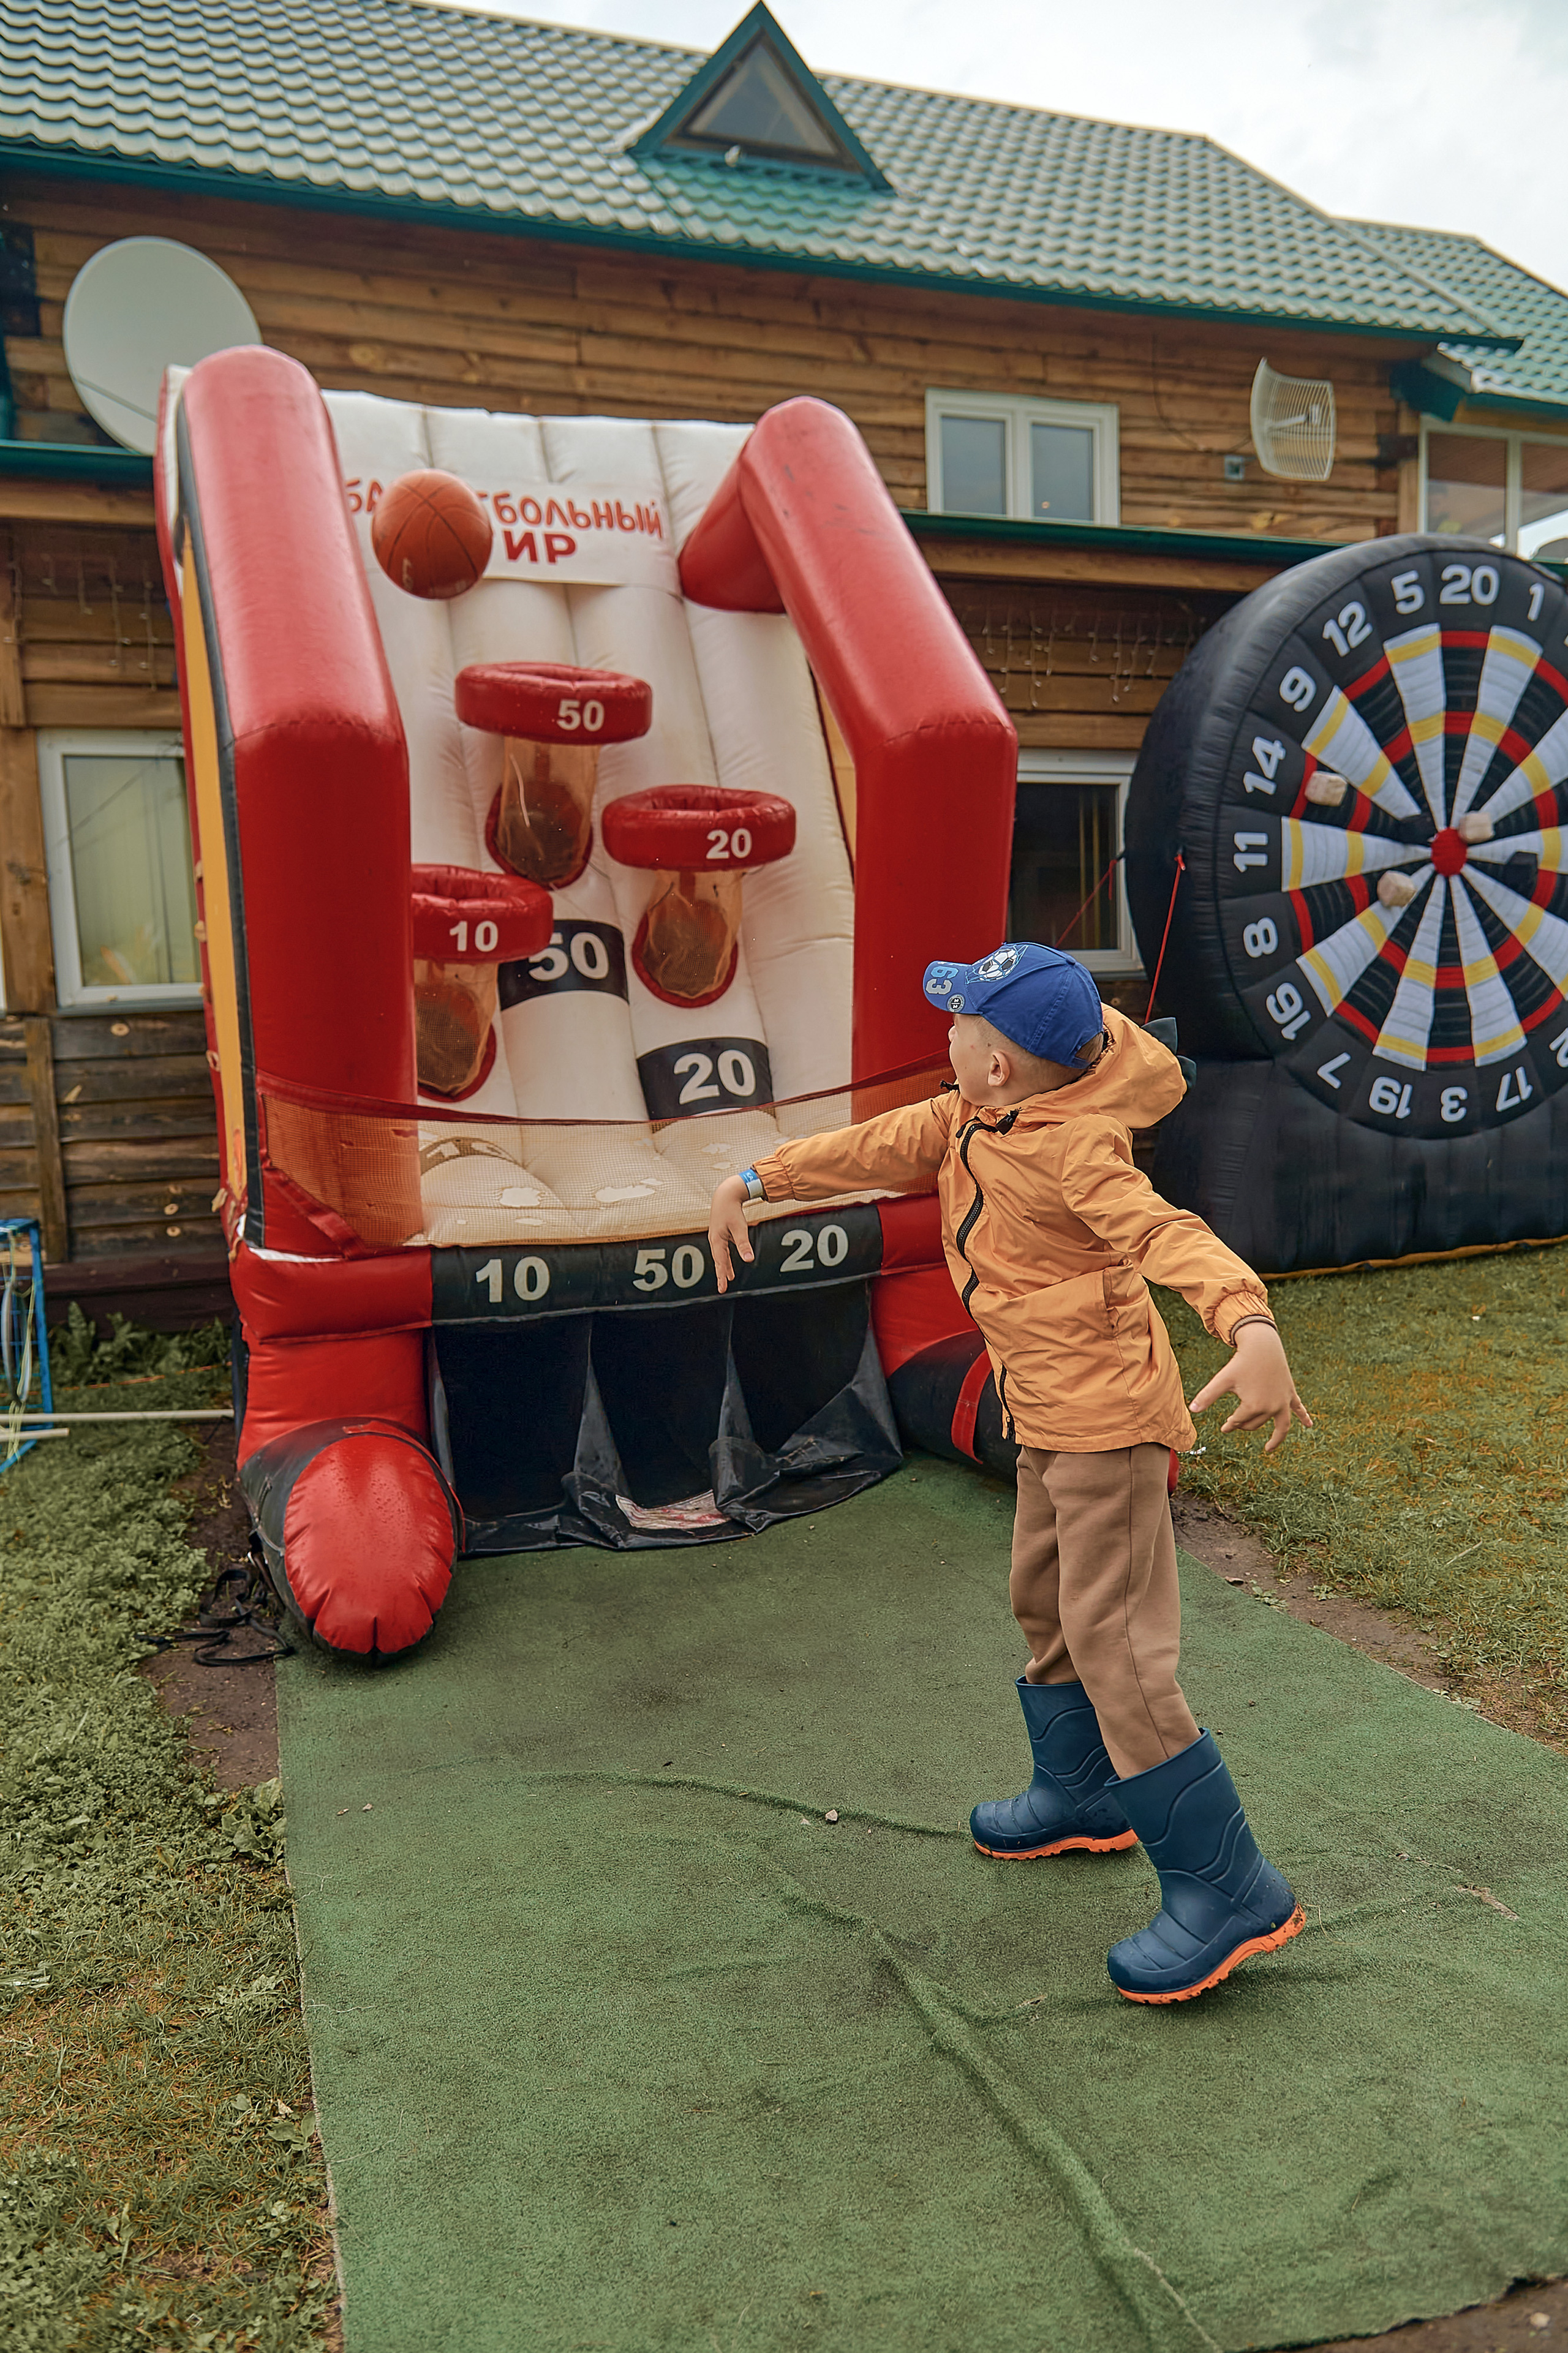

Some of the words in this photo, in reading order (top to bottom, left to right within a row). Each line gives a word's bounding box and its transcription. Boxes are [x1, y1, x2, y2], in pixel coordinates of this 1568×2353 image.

[502, 530, 576, 563] ИР
[1392, 571, 1423, 613] 5
[1441, 565, 1499, 604] 20
[1529, 583, 1544, 620] 1
[1323, 602, 1372, 655] 12
[1280, 667, 1316, 711] 9
[557, 699, 604, 731] 50
[1244, 737, 1286, 794] 14
[706, 829, 751, 859] 20
[1234, 832, 1268, 872] 11
[450, 921, 497, 951] 10
[529, 933, 608, 980] 50
[1243, 917, 1278, 957] 8
[1267, 983, 1310, 1039] 16
[674, 1050, 755, 1104] 20
[1317, 1053, 1351, 1088] 7
[1496, 1067, 1532, 1111] 17
[1370, 1077, 1412, 1118] 19
[1441, 1087, 1467, 1121] 3
[633, 1245, 704, 1290] 50
[780, 1225, 848, 1271] 20
[476, 1257, 549, 1302] 10
